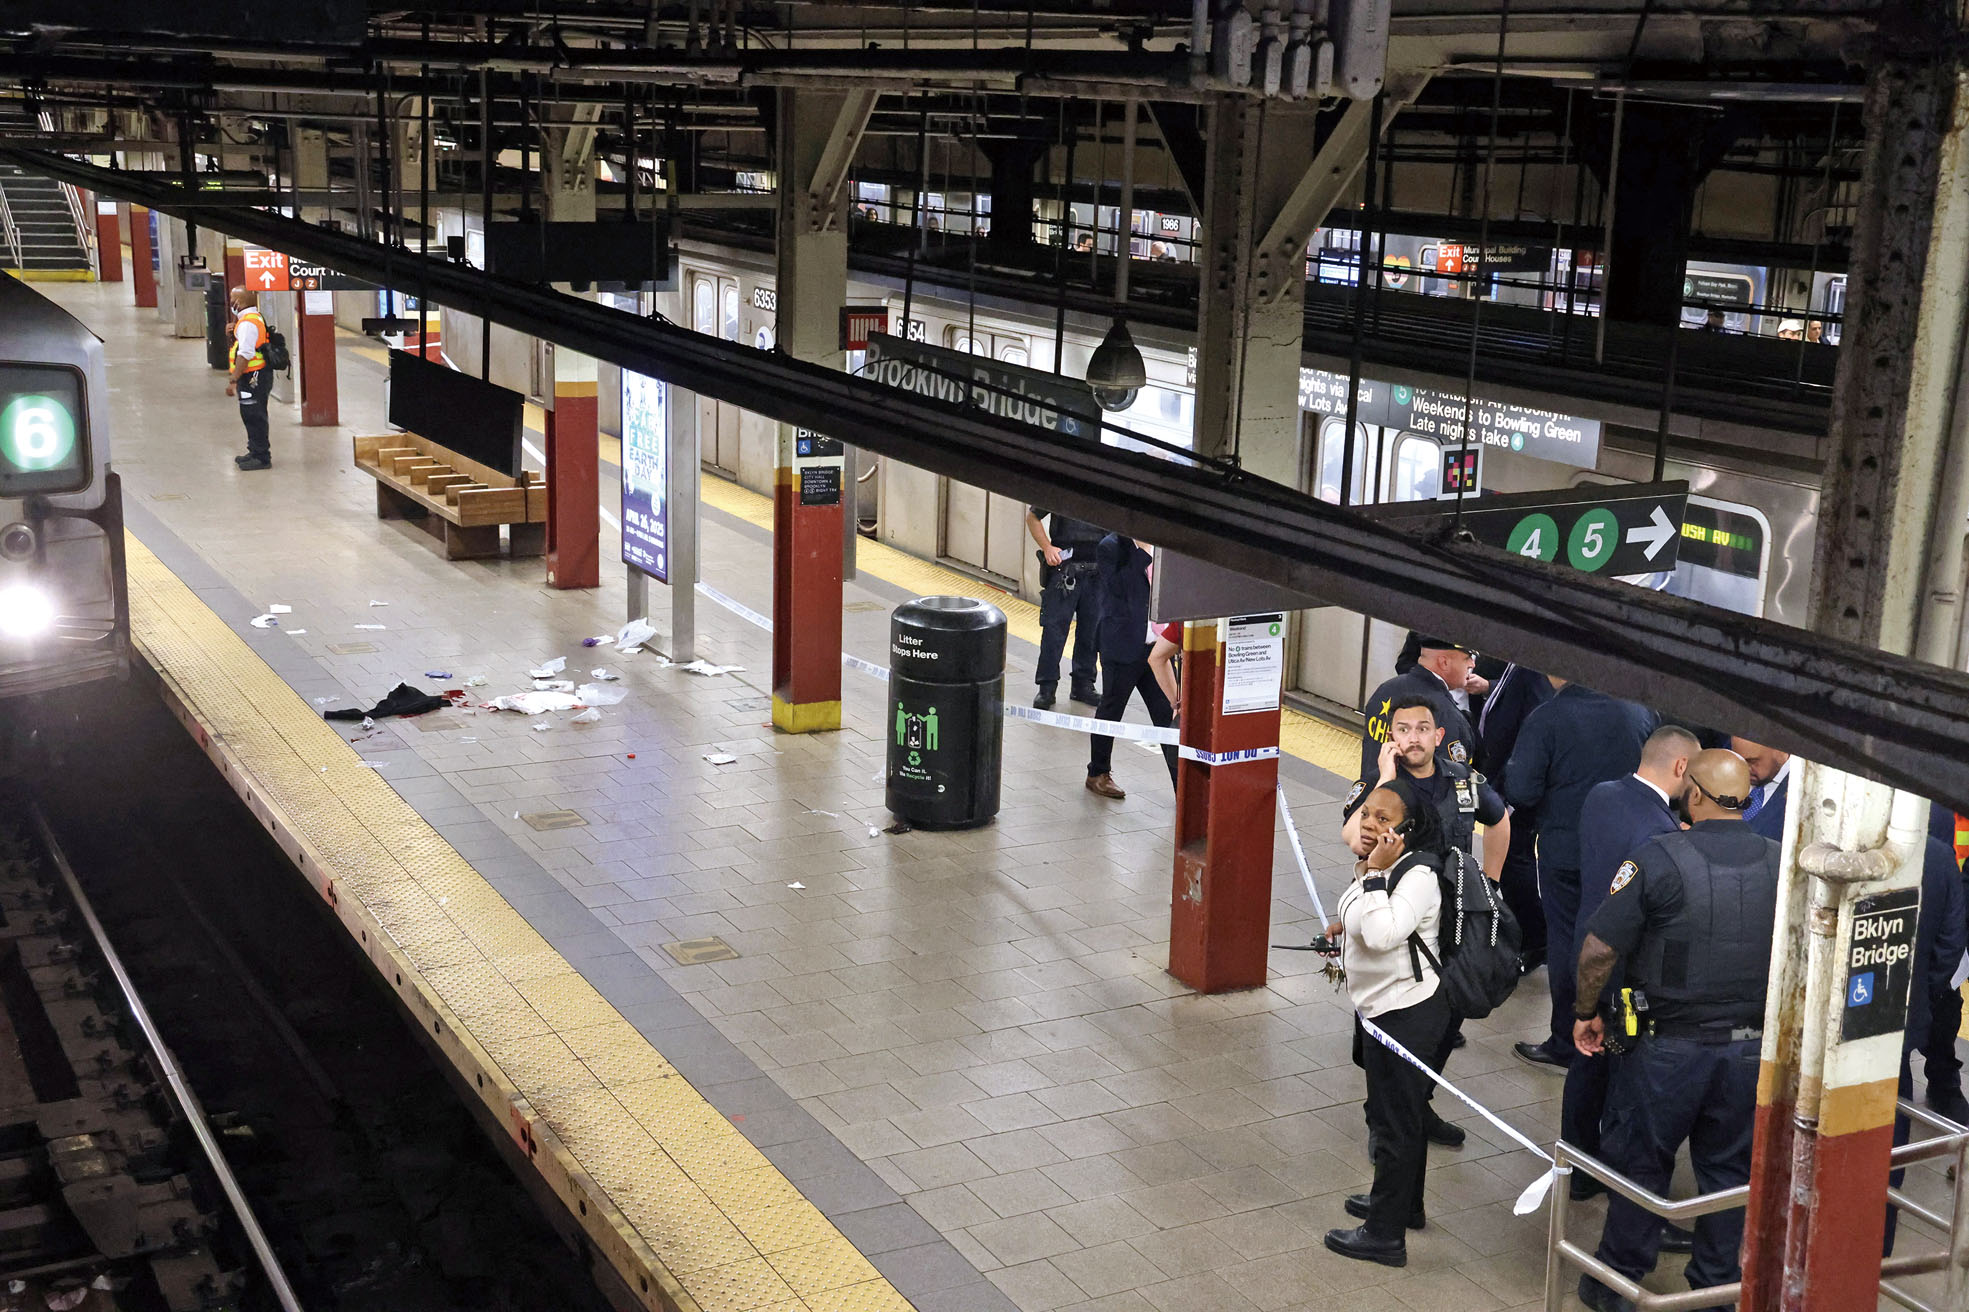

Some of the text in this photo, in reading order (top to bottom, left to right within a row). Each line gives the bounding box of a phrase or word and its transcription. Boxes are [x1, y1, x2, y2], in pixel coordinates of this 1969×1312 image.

[1162, 218, 1180, 231] 1986
[245, 251, 284, 269] Exit
[1439, 246, 1460, 258] Exit
[1462, 254, 1480, 263] Cour
[289, 264, 326, 277] Court
[754, 288, 776, 311] 6353
[1330, 381, 1345, 397] via
[1309, 394, 1332, 413] Lots
[1412, 395, 1474, 423] Weekends
[1478, 409, 1492, 426] to
[1494, 414, 1541, 438] Bowling
[1544, 420, 1582, 443] Green
[15, 406, 58, 459] 6
[1409, 413, 1436, 433] Late
[1481, 428, 1509, 448] take
[629, 429, 660, 453] FREE
[628, 447, 660, 471] EARTH
[633, 465, 653, 481] DAY
[1520, 521, 1605, 559] 4 5
[1712, 529, 1731, 546] AV
[898, 633, 924, 646] Litter
[891, 643, 939, 660] Stops Here
[1195, 748, 1217, 763] CROSS
[1220, 750, 1240, 763] NOT
[1244, 748, 1258, 759] DO
[1854, 916, 1904, 941] Bklyn
[1851, 943, 1909, 966] Bridge
